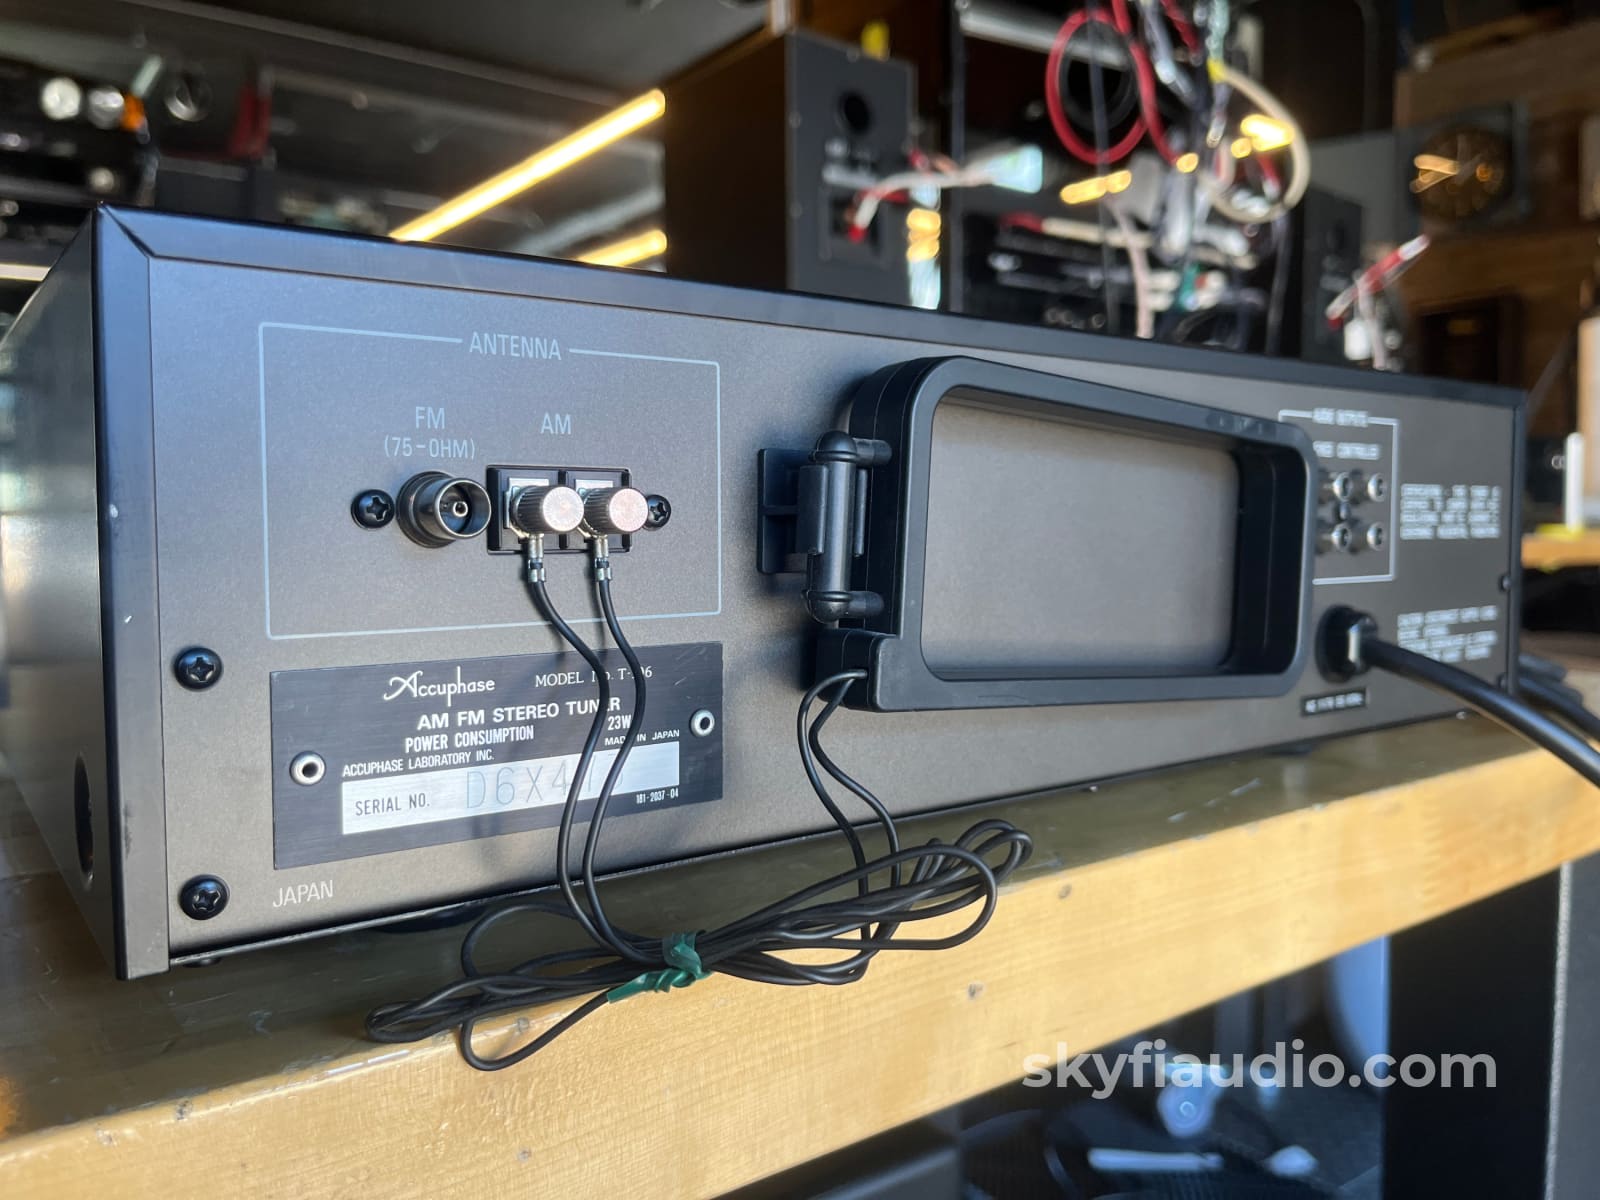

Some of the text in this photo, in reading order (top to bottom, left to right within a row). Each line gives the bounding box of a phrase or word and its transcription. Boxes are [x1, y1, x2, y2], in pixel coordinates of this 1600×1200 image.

[469, 331, 562, 361] ANTENNA
[415, 406, 446, 430] FM
[540, 412, 572, 435] AM
[384, 436, 476, 461] (75-OHM)
[383, 665, 496, 707] Accuphase
[535, 671, 585, 688] MODEL
[417, 696, 621, 730] AM FM STEREO TUNR
[405, 714, 632, 753] POWER CONSUMPTION 23W
[604, 729, 680, 746] MAD IN JAPAN
[342, 748, 496, 778] ACCUPHASE LABORATORY INC.
[355, 796, 402, 816] SERIAL
[409, 792, 431, 808] NO.
[272, 880, 334, 907] JAPAN
